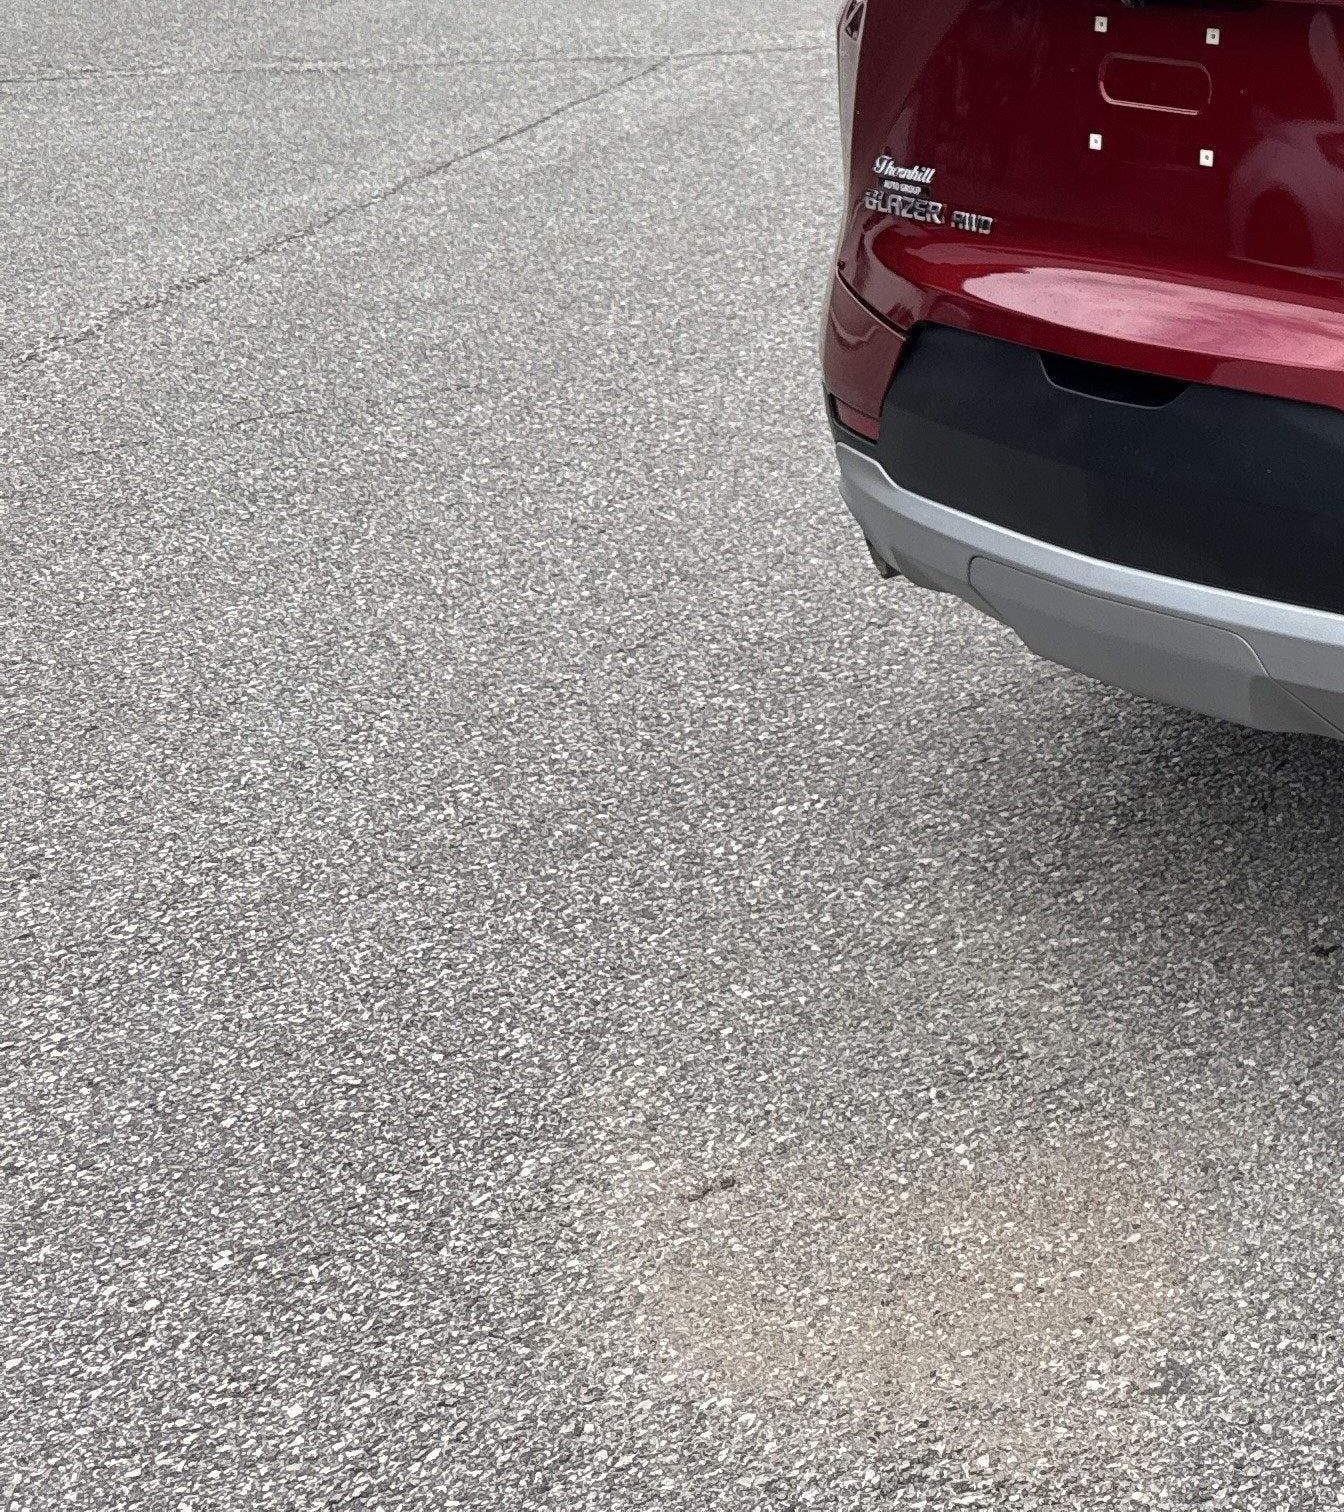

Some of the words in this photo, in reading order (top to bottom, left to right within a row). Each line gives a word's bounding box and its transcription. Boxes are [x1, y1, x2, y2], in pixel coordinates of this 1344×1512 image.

[872, 155, 936, 183] Thornhill
[864, 188, 944, 224] BLAZER
[950, 210, 994, 235] AWD
